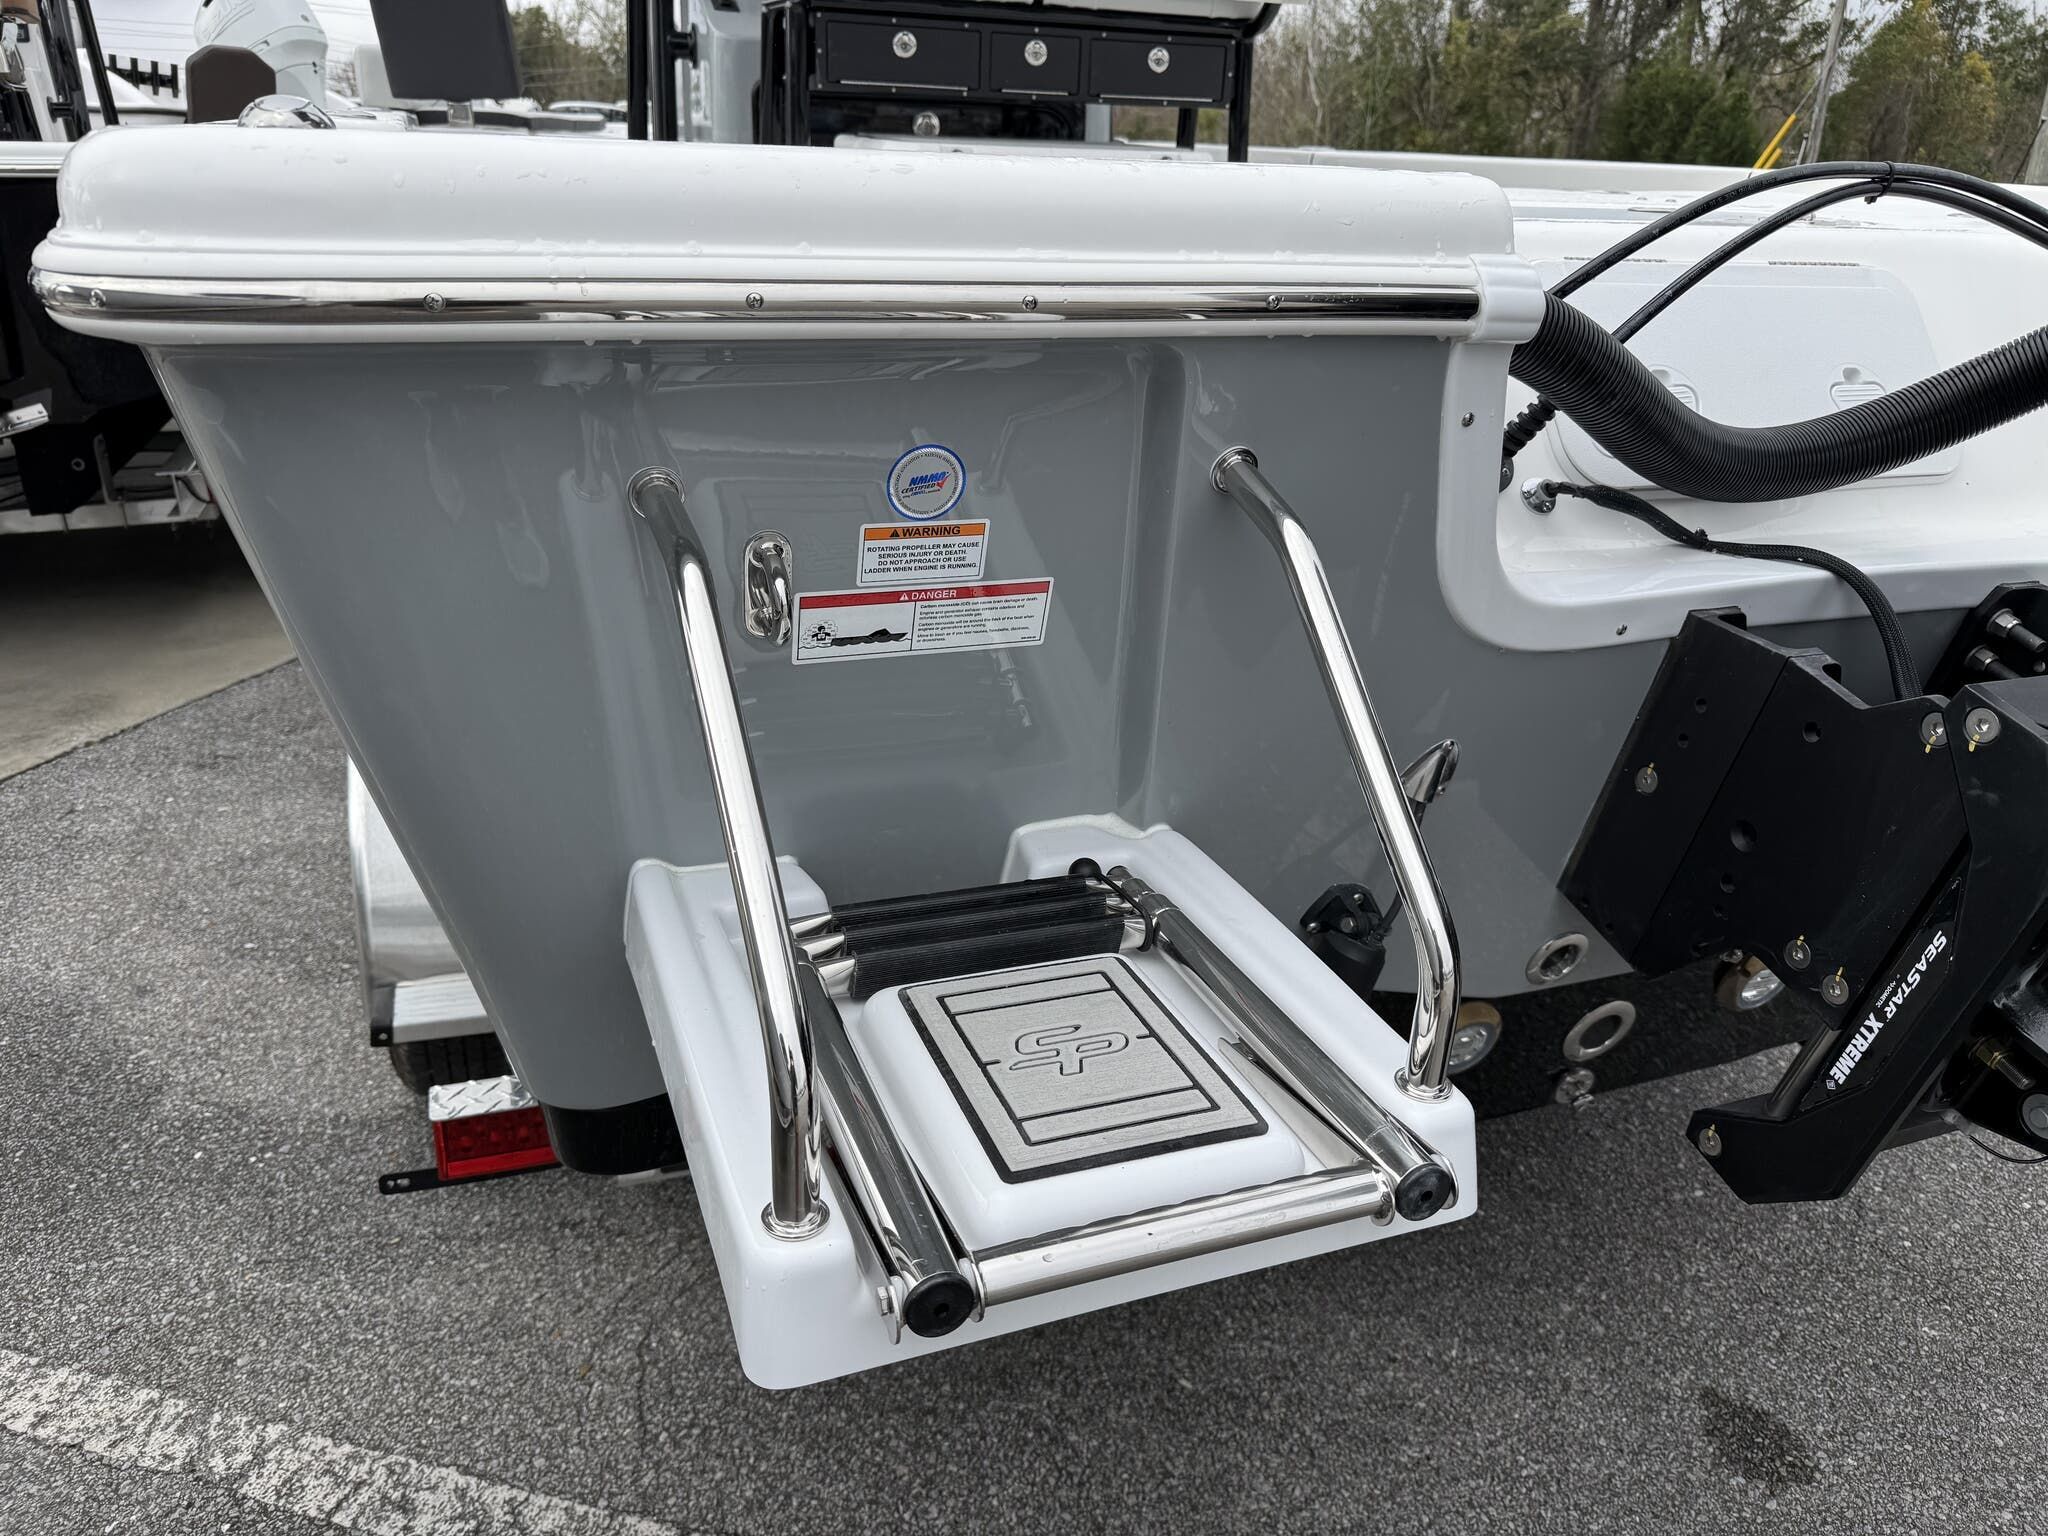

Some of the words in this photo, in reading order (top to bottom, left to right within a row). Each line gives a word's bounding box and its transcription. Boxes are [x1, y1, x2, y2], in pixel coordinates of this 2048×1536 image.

[901, 483, 936, 494] CERTIFIED
[902, 526, 960, 537] WARNING
[904, 557, 941, 565] APPROACH
[911, 590, 957, 600] DANGER
[1884, 930, 1947, 1019] SEASTAR
[1829, 1012, 1884, 1085] XTREME
